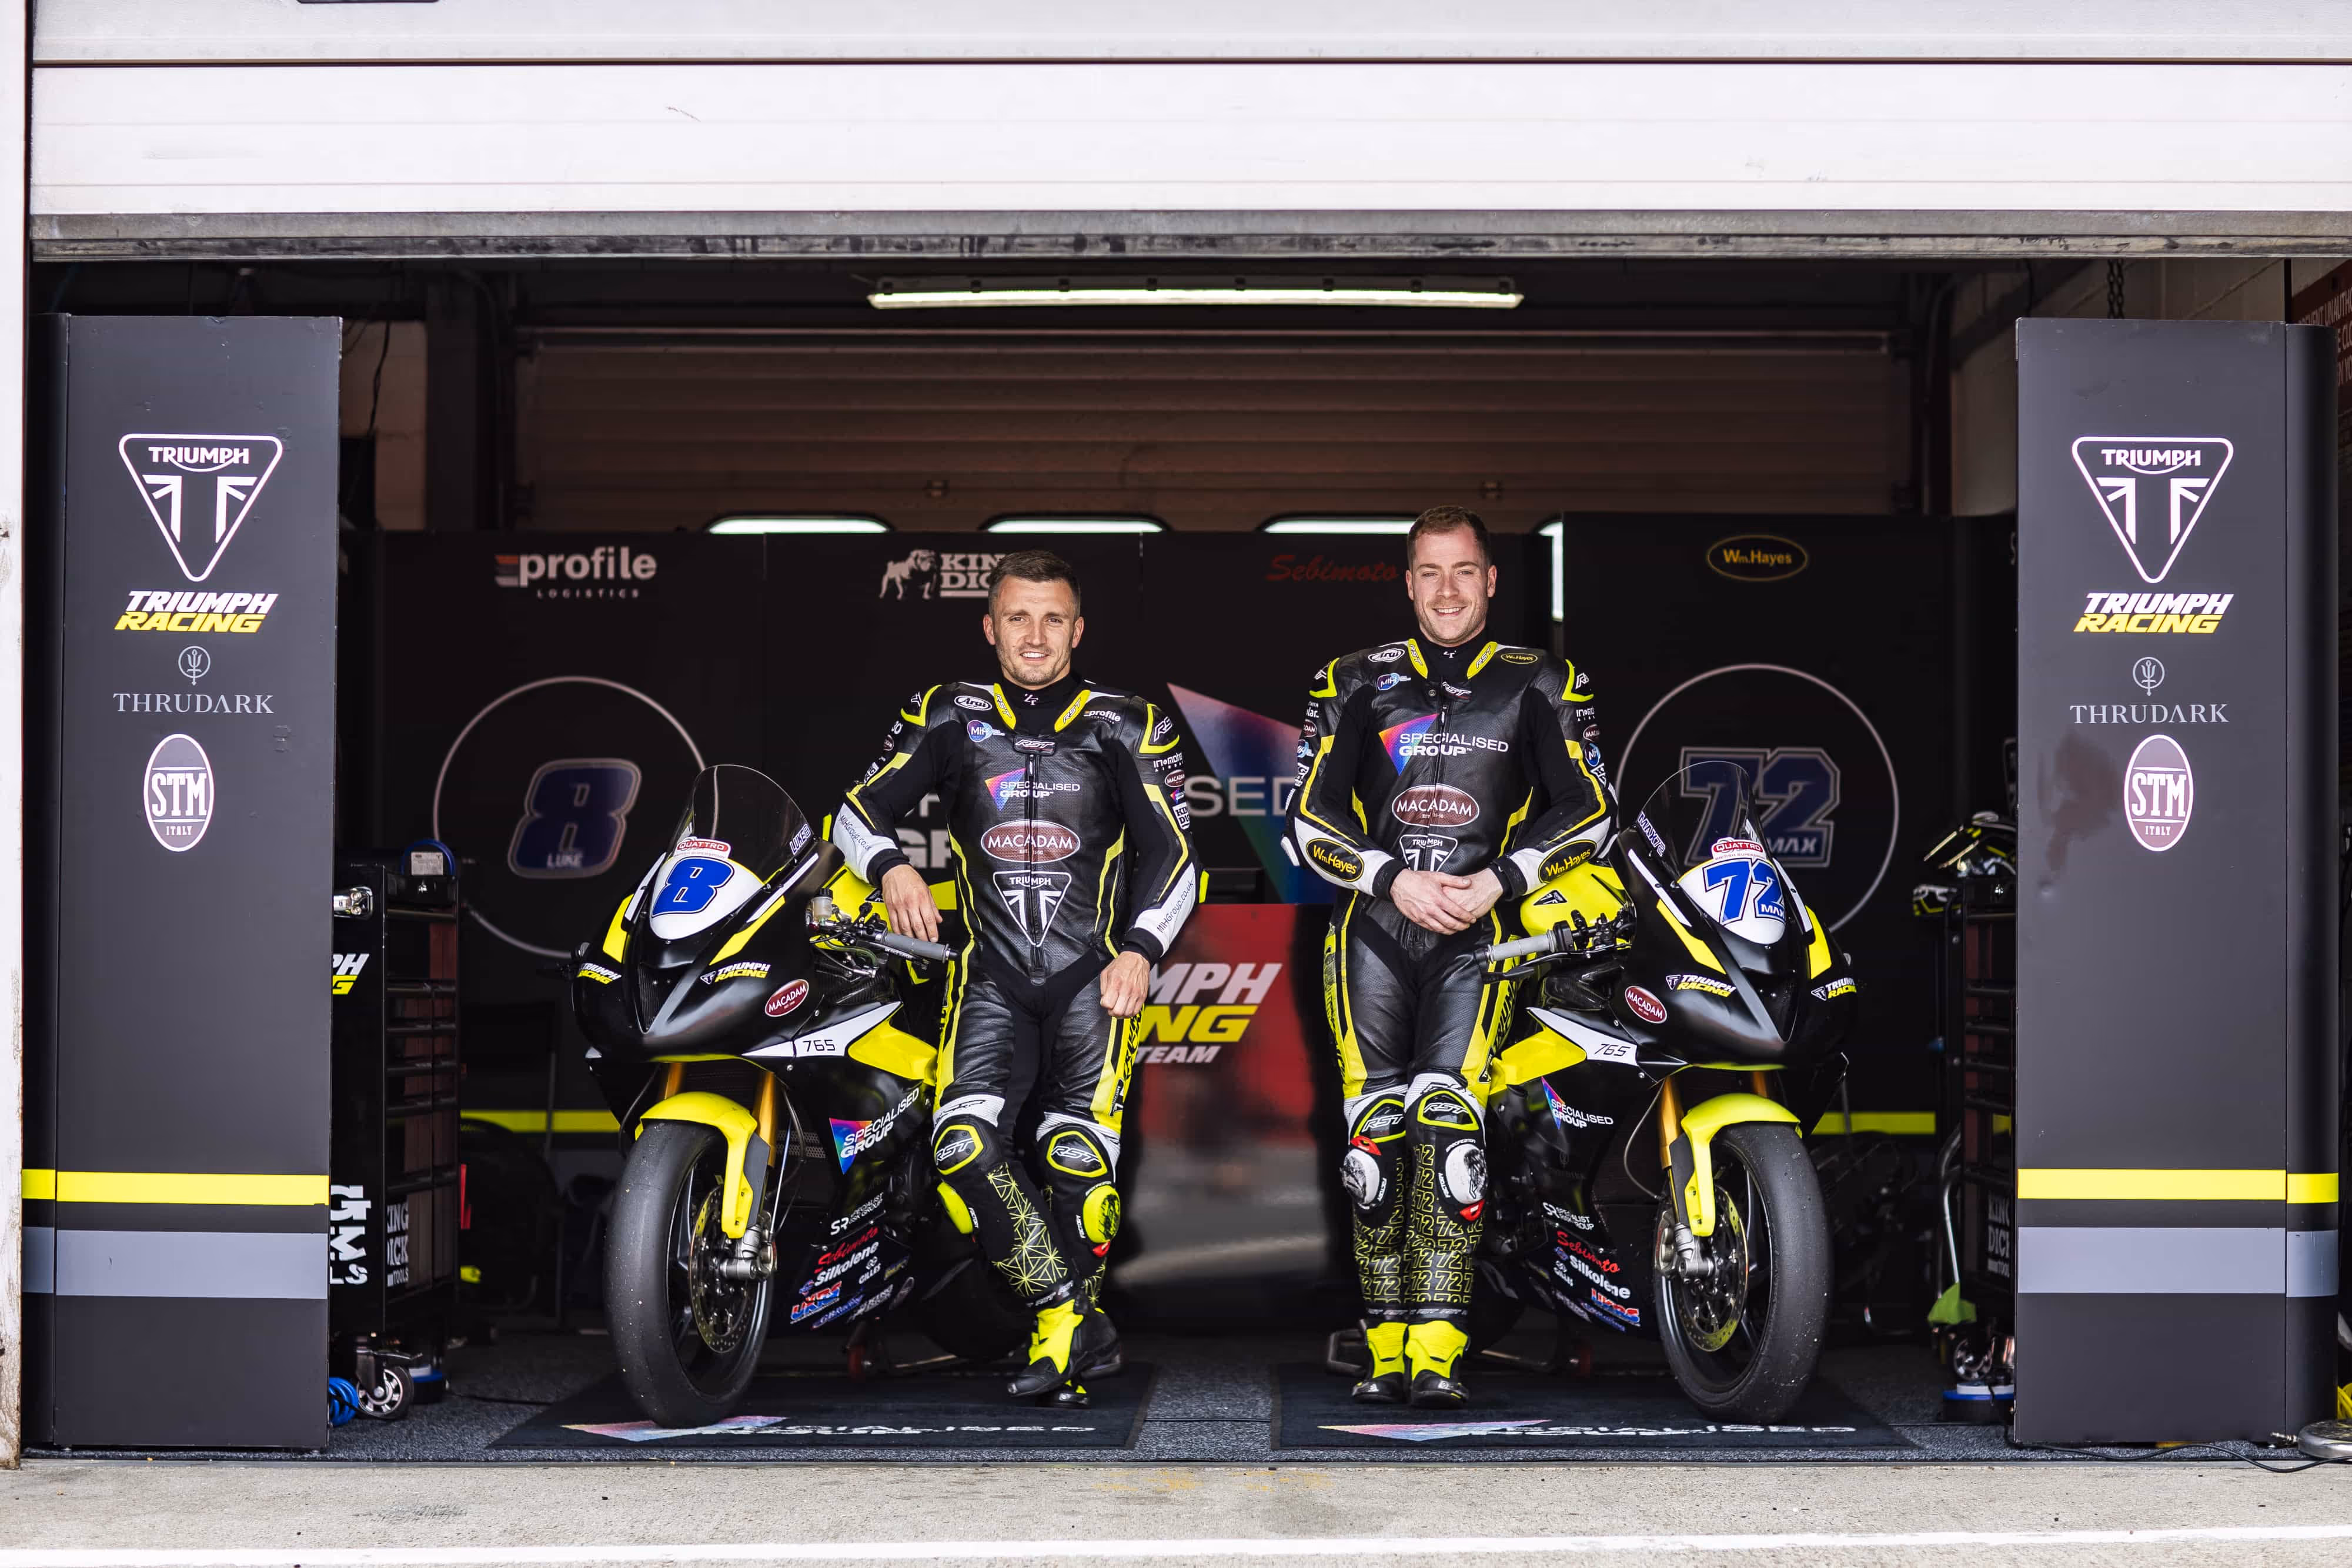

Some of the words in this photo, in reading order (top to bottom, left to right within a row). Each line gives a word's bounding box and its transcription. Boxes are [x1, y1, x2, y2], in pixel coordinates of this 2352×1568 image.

[148, 446, 249, 472] TRIUMPH
[2101, 449, 2201, 474] TRIUMPH
[519, 546, 657, 587] profile
[941, 554, 1005, 570] KIN
[1266, 555, 1399, 581] Sebimoto
[126, 590, 278, 613] TRIUMPH
[537, 589, 639, 599] LOGISTICS
[2084, 593, 2234, 614] TRIUMPH
[115, 611, 266, 633] RACING
[2073, 614, 2223, 633] RACING
[1410, 644, 1423, 666] RST
[1476, 646, 1492, 668] RST
[113, 693, 275, 714] THRUDARK
[995, 693, 1012, 718] RST
[1062, 698, 1081, 724] RST
[1090, 710, 1121, 722] profile
[2070, 704, 2229, 724] THRUDARK
[1015, 739, 1055, 749] RST
[1399, 733, 1509, 753] SPECIALISED
[1399, 745, 1467, 756] GROUP
[152, 773, 207, 817] STM
[1000, 781, 1080, 791] SPECIALISED
[1000, 790, 1051, 798] GROUP
[2132, 773, 2186, 817] STM
[1396, 798, 1472, 817] MACADAM
[1681, 747, 1840, 867] 72
[508, 758, 642, 878] 8
[166, 825, 193, 835] ITALY
[2146, 825, 2171, 835] ITALY
[679, 841, 724, 851] QUATTRO
[988, 834, 1073, 850] MACADAM
[1412, 838, 1443, 848] TRIUMPH
[1716, 842, 1760, 851] QUATTRO
[1768, 837, 1817, 854] MAX
[547, 852, 584, 869] LUKE
[1313, 844, 1358, 875] Wm.Hayes
[1545, 848, 1591, 877] Wm.Hayes
[652, 856, 735, 918] 8
[1010, 875, 1051, 889] TRIUMPH
[1703, 857, 1786, 926] 72
[1761, 904, 1784, 918] MAX
[714, 969, 767, 982] RACING
[717, 962, 771, 976] TRIUMPH
[1677, 982, 1732, 998] RACING
[1681, 974, 1736, 993] TRIUMPH
[769, 984, 806, 1012] MACADAM
[1627, 990, 1663, 1019] MACADAM
[802, 1039, 837, 1051] 765
[1135, 1046, 1221, 1063] TEAM
[1594, 1044, 1631, 1057] 765
[844, 1088, 919, 1146] SPECIALISED
[1424, 1102, 1470, 1115] RST
[1551, 1098, 1614, 1125] SPECIALISED
[1552, 1108, 1587, 1128] GROUP
[1361, 1115, 1404, 1132] RST
[840, 1121, 894, 1158] GROUP
[935, 1138, 974, 1165] RST
[1051, 1145, 1100, 1163] RST
[814, 1241, 880, 1287] Silkolene
[1569, 1255, 1631, 1299] Silkolene
